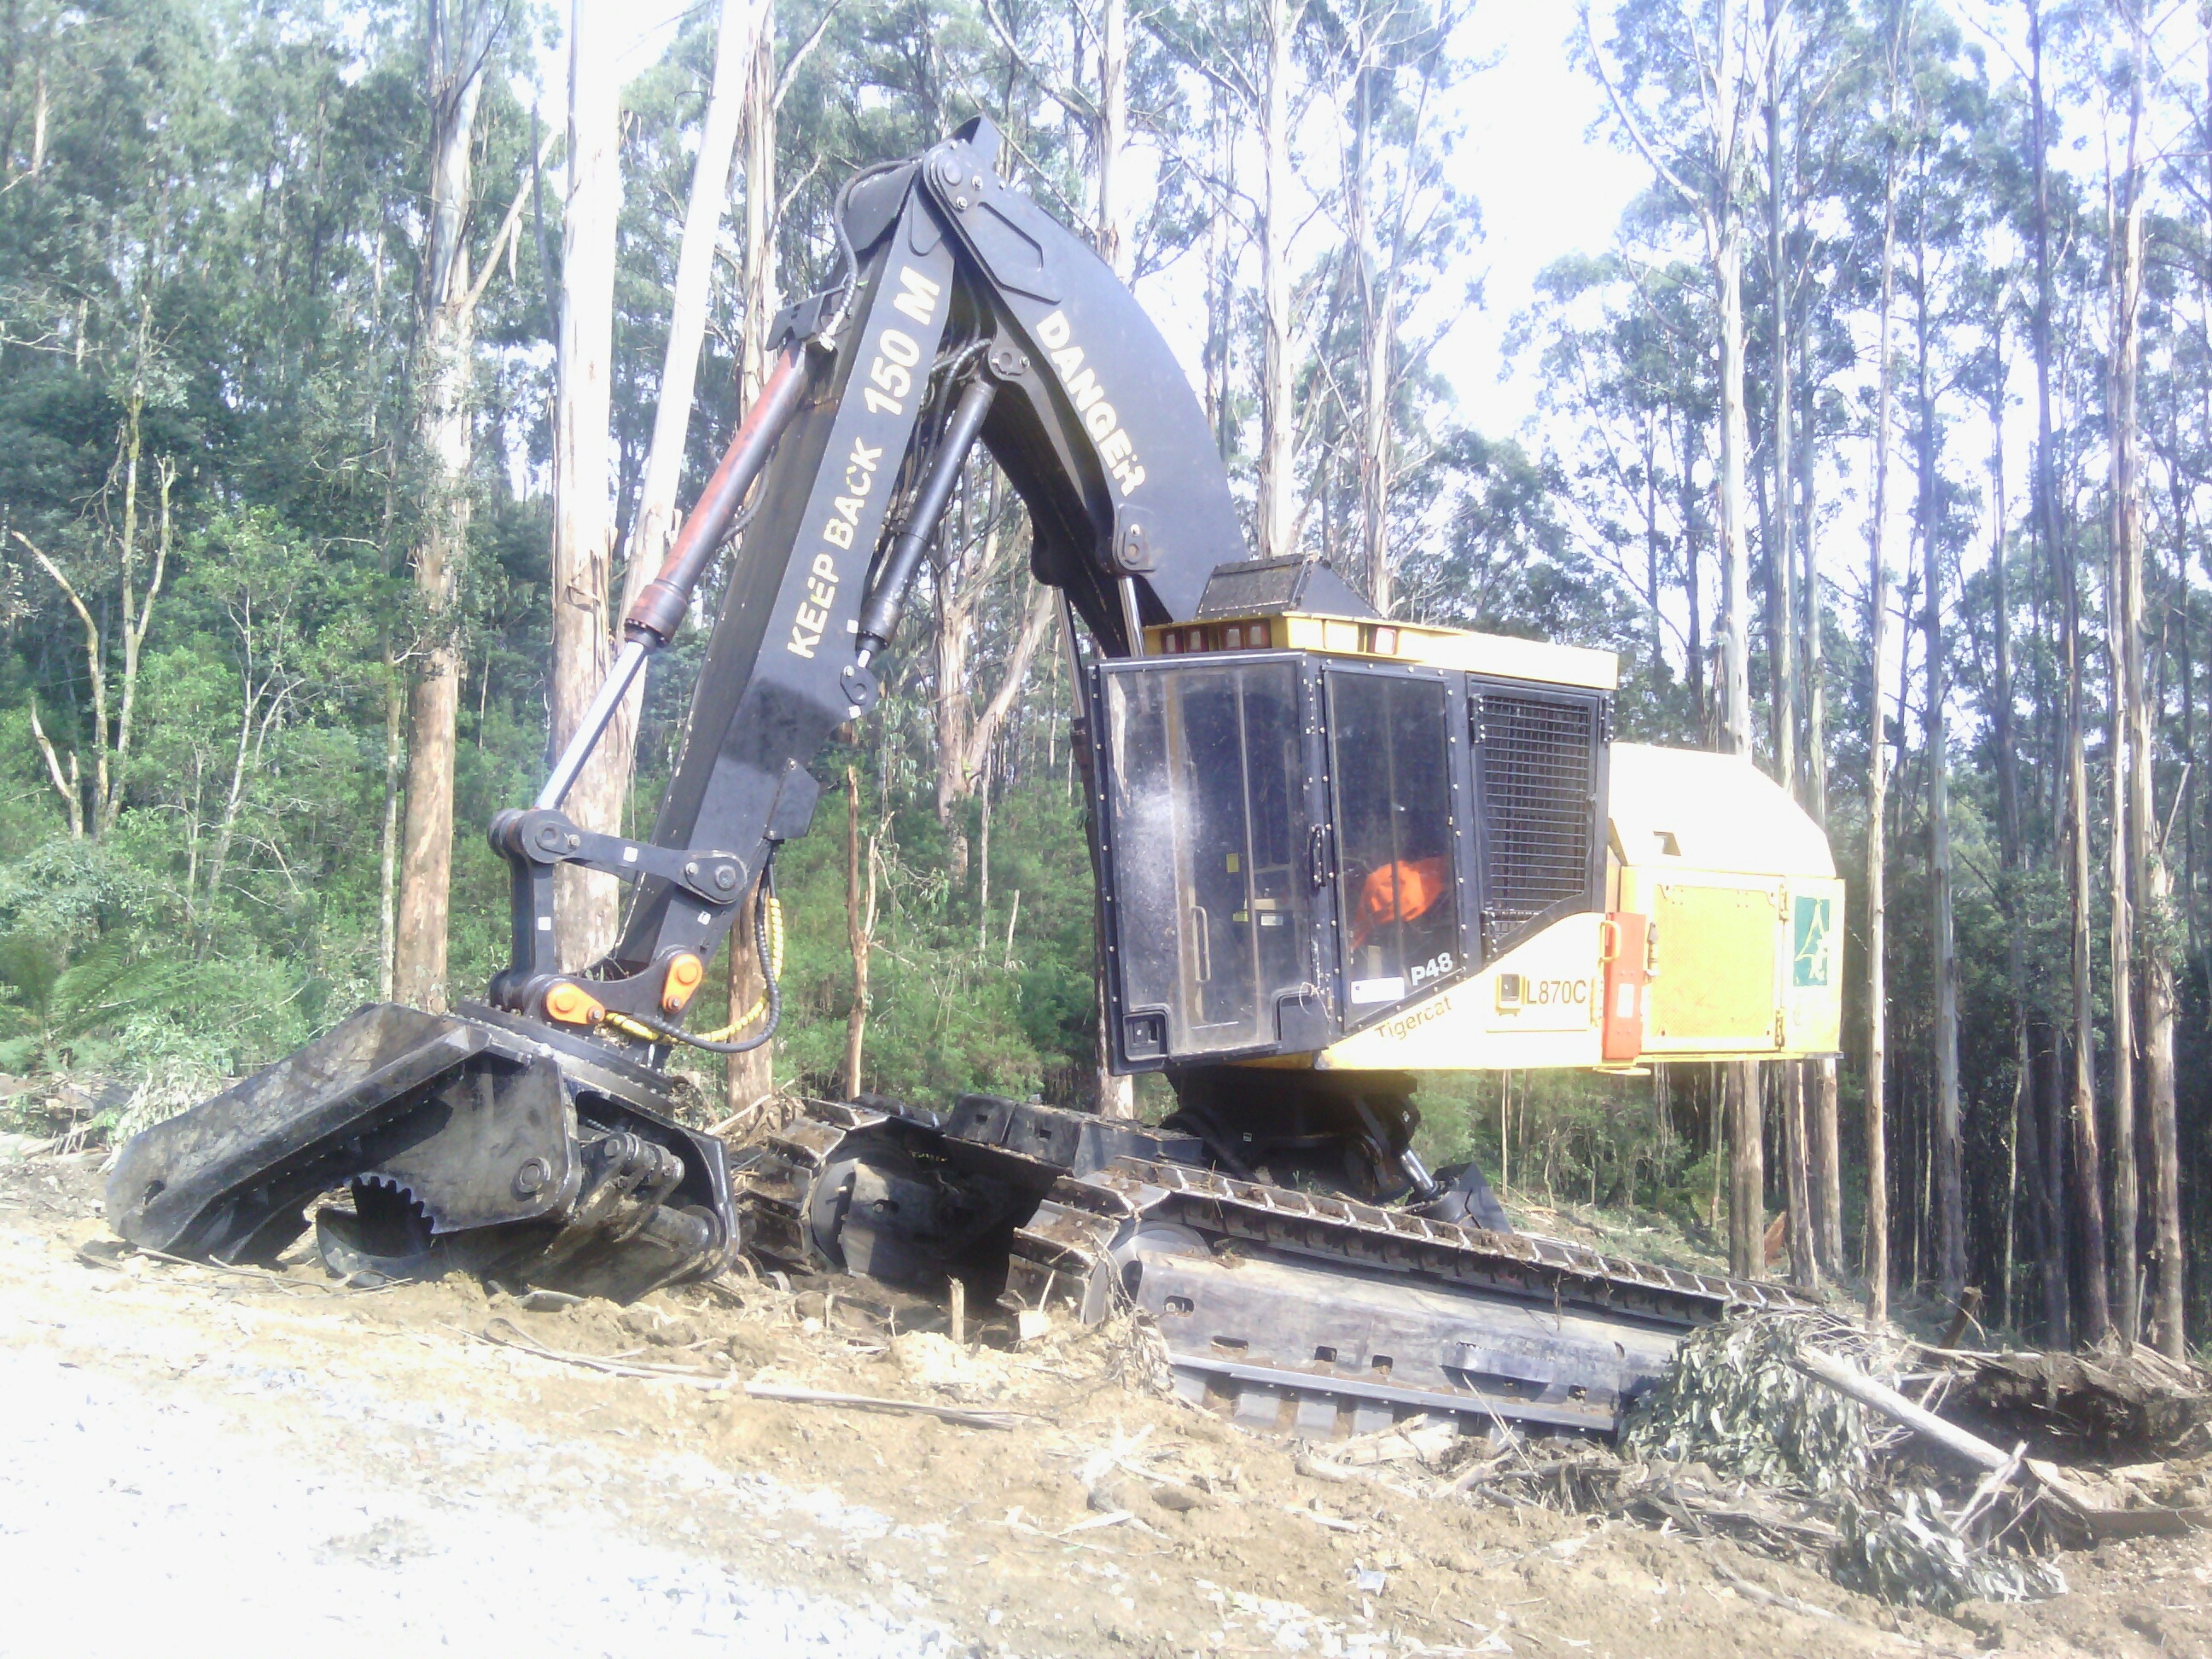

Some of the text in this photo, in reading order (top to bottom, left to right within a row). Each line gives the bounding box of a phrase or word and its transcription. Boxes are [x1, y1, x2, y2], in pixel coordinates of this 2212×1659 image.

[1035, 309, 1146, 498] DANGER
[787, 265, 940, 659] KEEP BACK 150 M
[1410, 952, 1453, 987] P48
[1526, 980, 1586, 1004] L870C
[1374, 995, 1452, 1040] Tigercat
